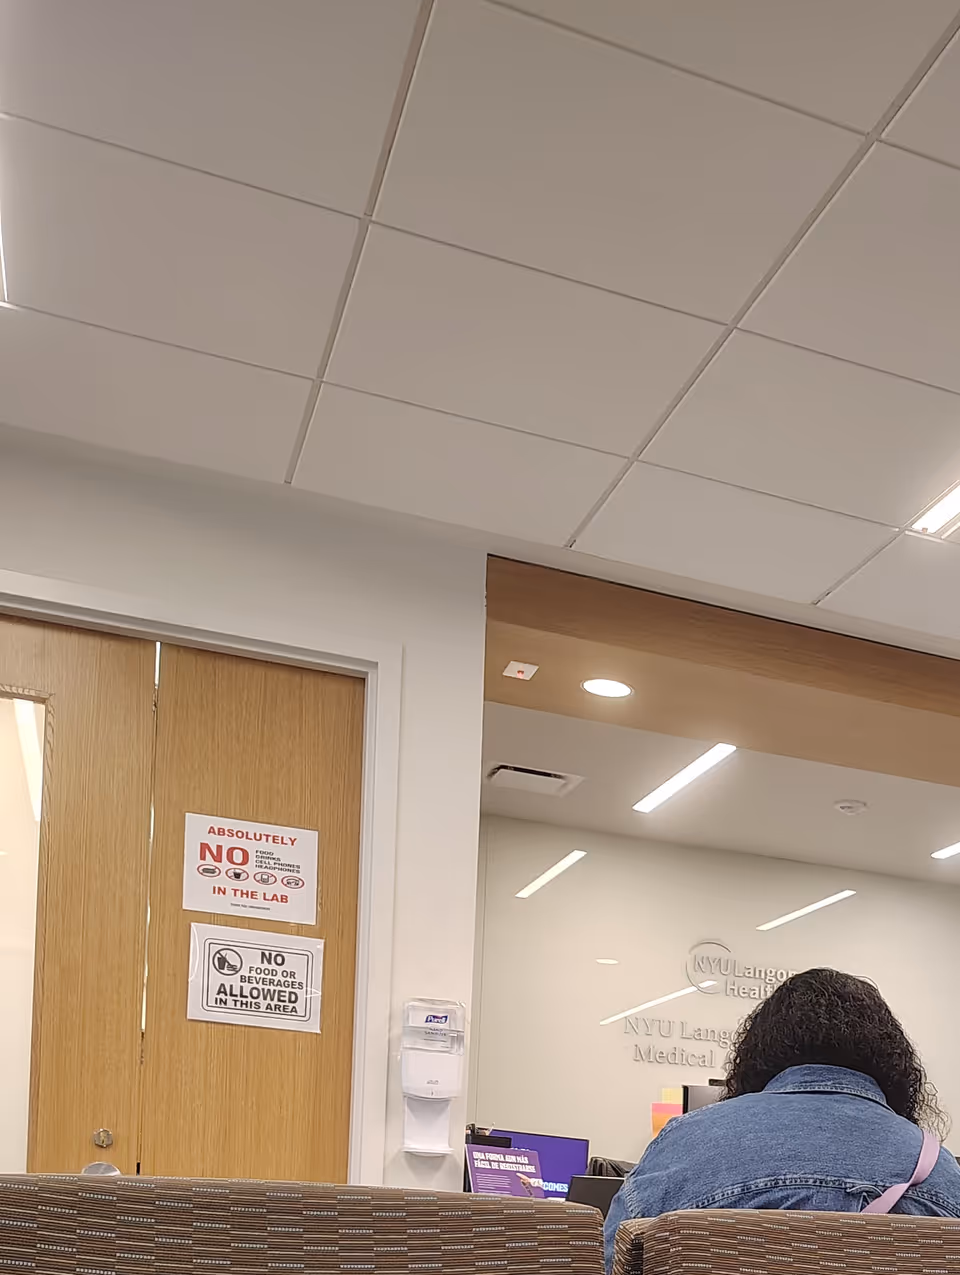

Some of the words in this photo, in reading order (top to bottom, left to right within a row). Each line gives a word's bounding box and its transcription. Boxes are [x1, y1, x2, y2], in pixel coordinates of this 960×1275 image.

[208, 826, 297, 846] ABSOLUTELY
[200, 842, 249, 866] NO
[255, 854, 281, 862] DRINKS
[255, 864, 300, 874] HEADPHONES
[212, 886, 226, 895] IN
[231, 888, 259, 899] THE
[263, 892, 288, 903] LAB
[260, 951, 285, 966] NO
[248, 966, 278, 977] FOOD
[281, 970, 296, 979] OR
[240, 975, 304, 990] BEVERAGES
[216, 983, 299, 1004] ALLOWED
[214, 997, 228, 1006] IN
[232, 1000, 261, 1010] THIS
[265, 1003, 298, 1014] AREA
[624, 1016, 675, 1038] NYU
[633, 1045, 716, 1068] Medical
